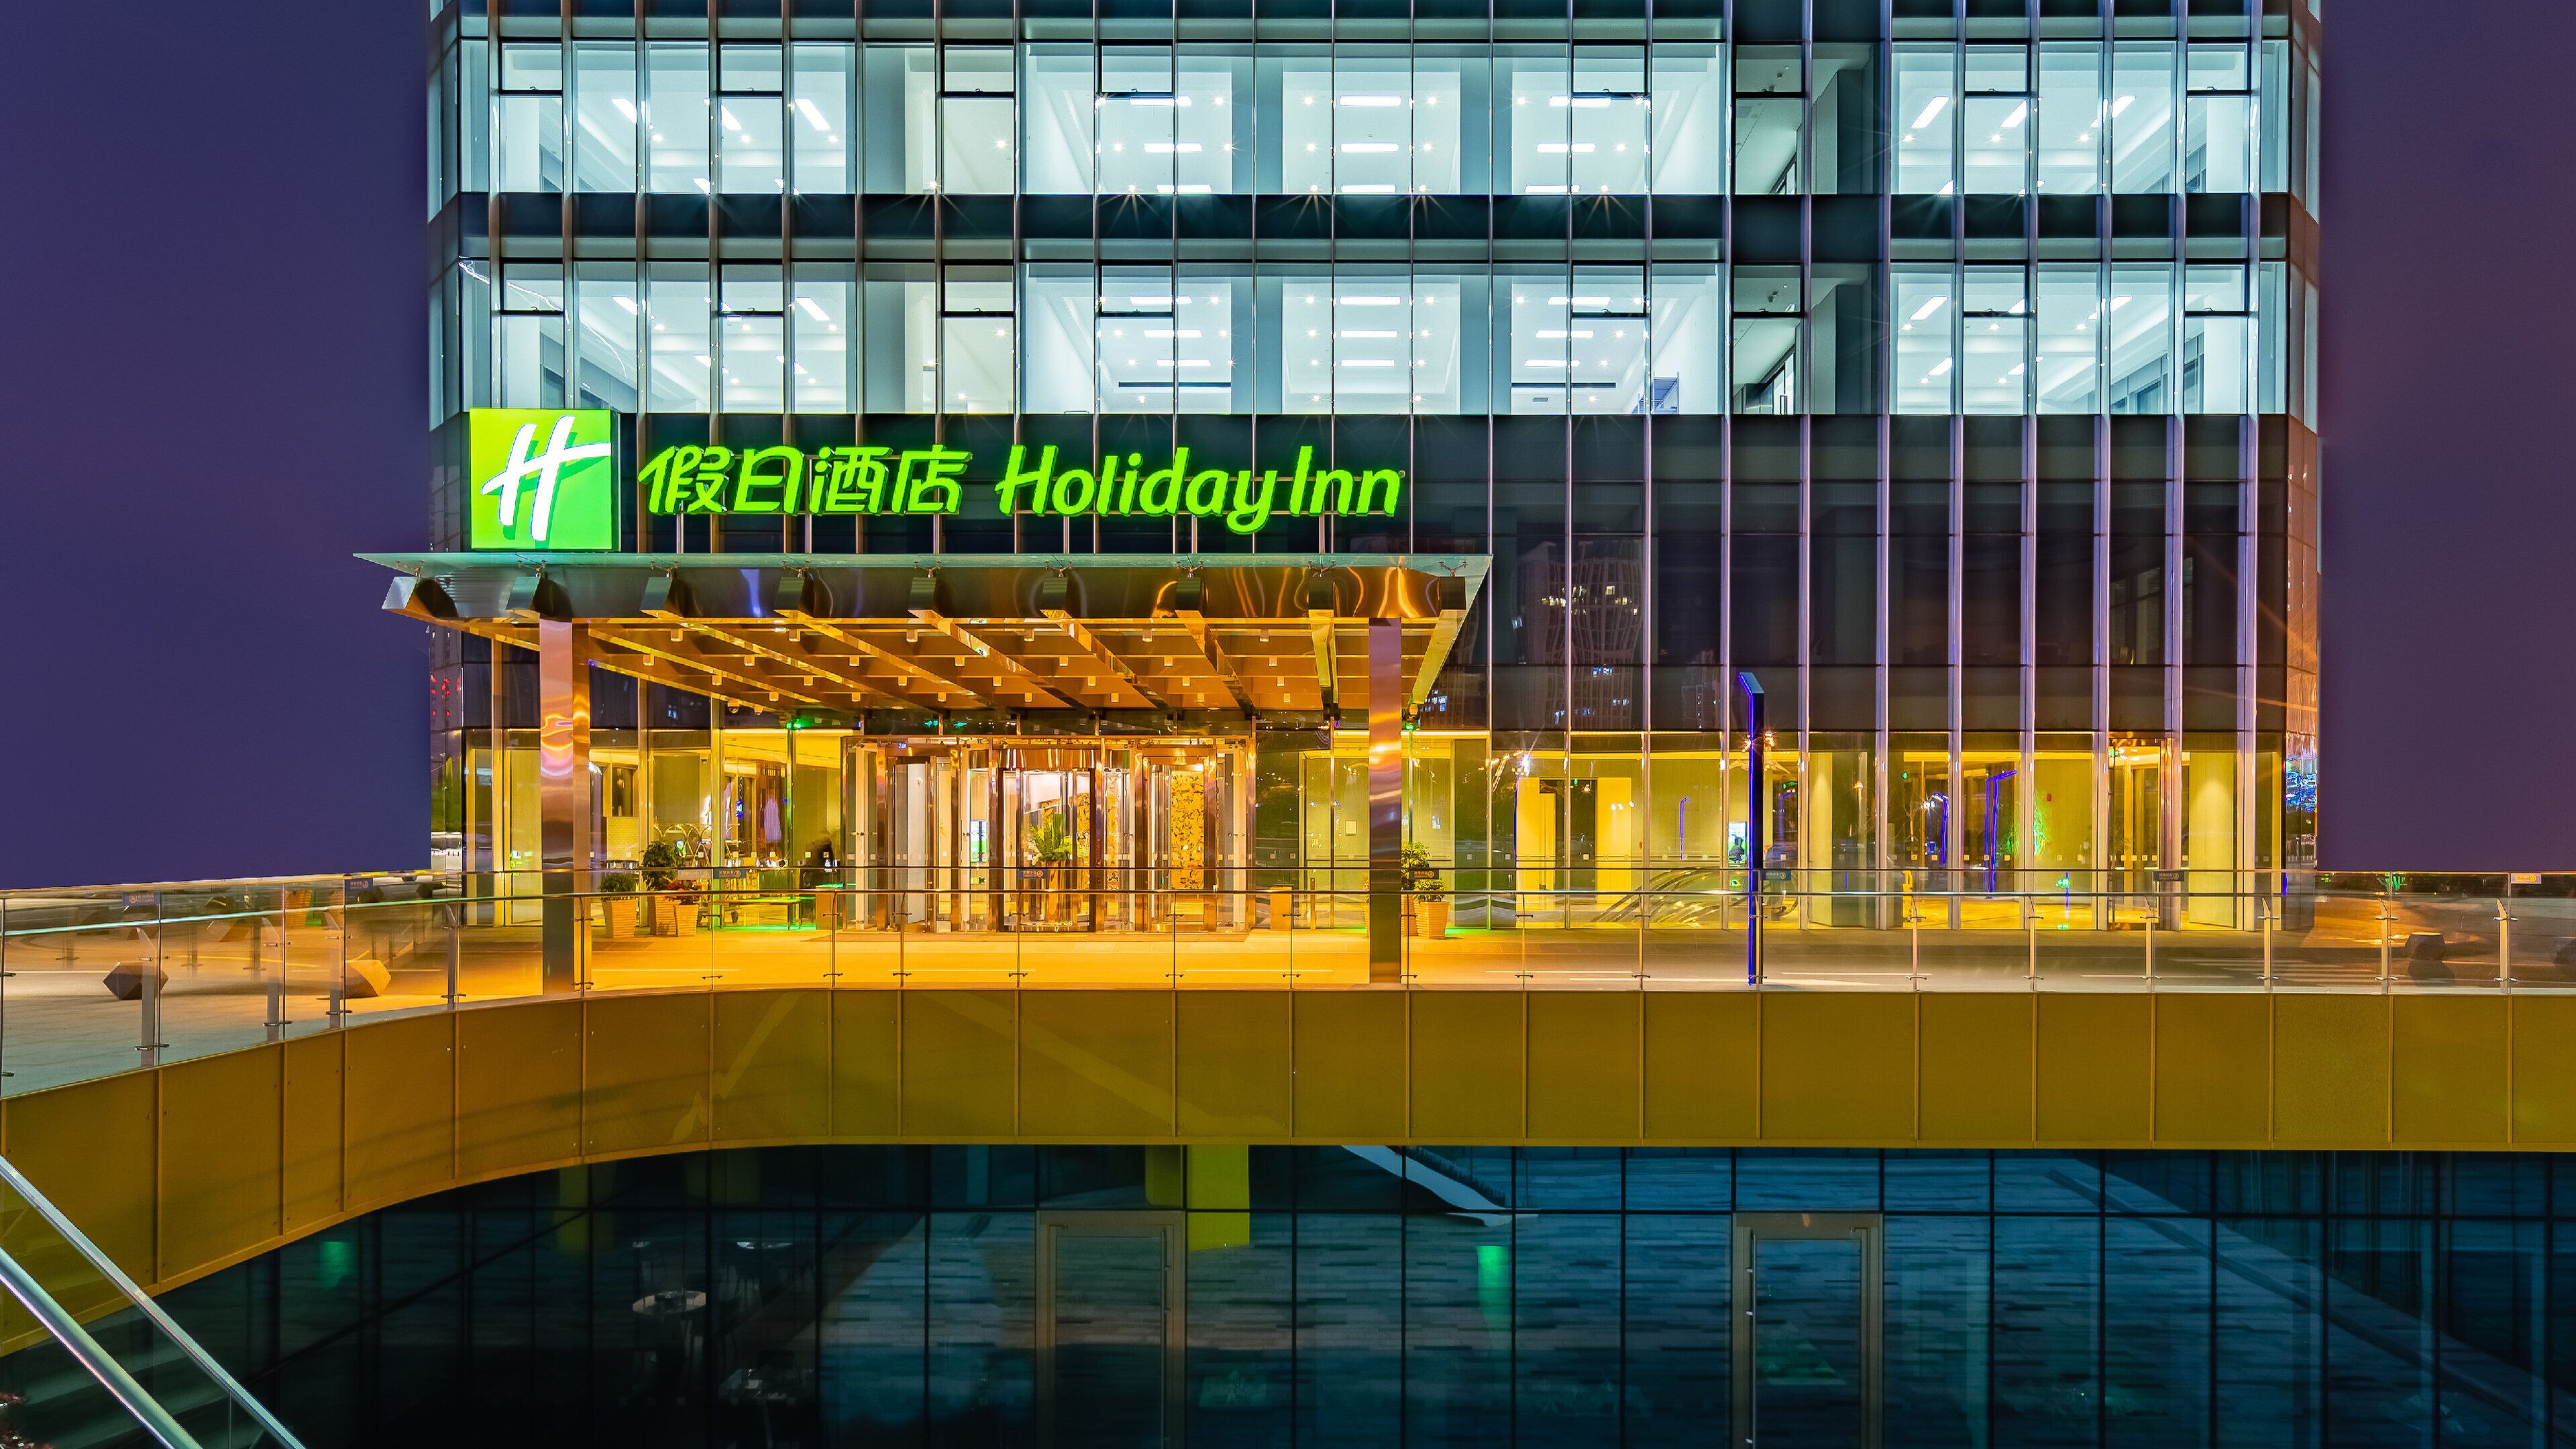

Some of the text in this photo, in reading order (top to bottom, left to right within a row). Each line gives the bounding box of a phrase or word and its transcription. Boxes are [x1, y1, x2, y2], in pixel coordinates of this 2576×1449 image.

[638, 444, 974, 515] 假日酒店
[995, 444, 1401, 534] Holiday Inn
